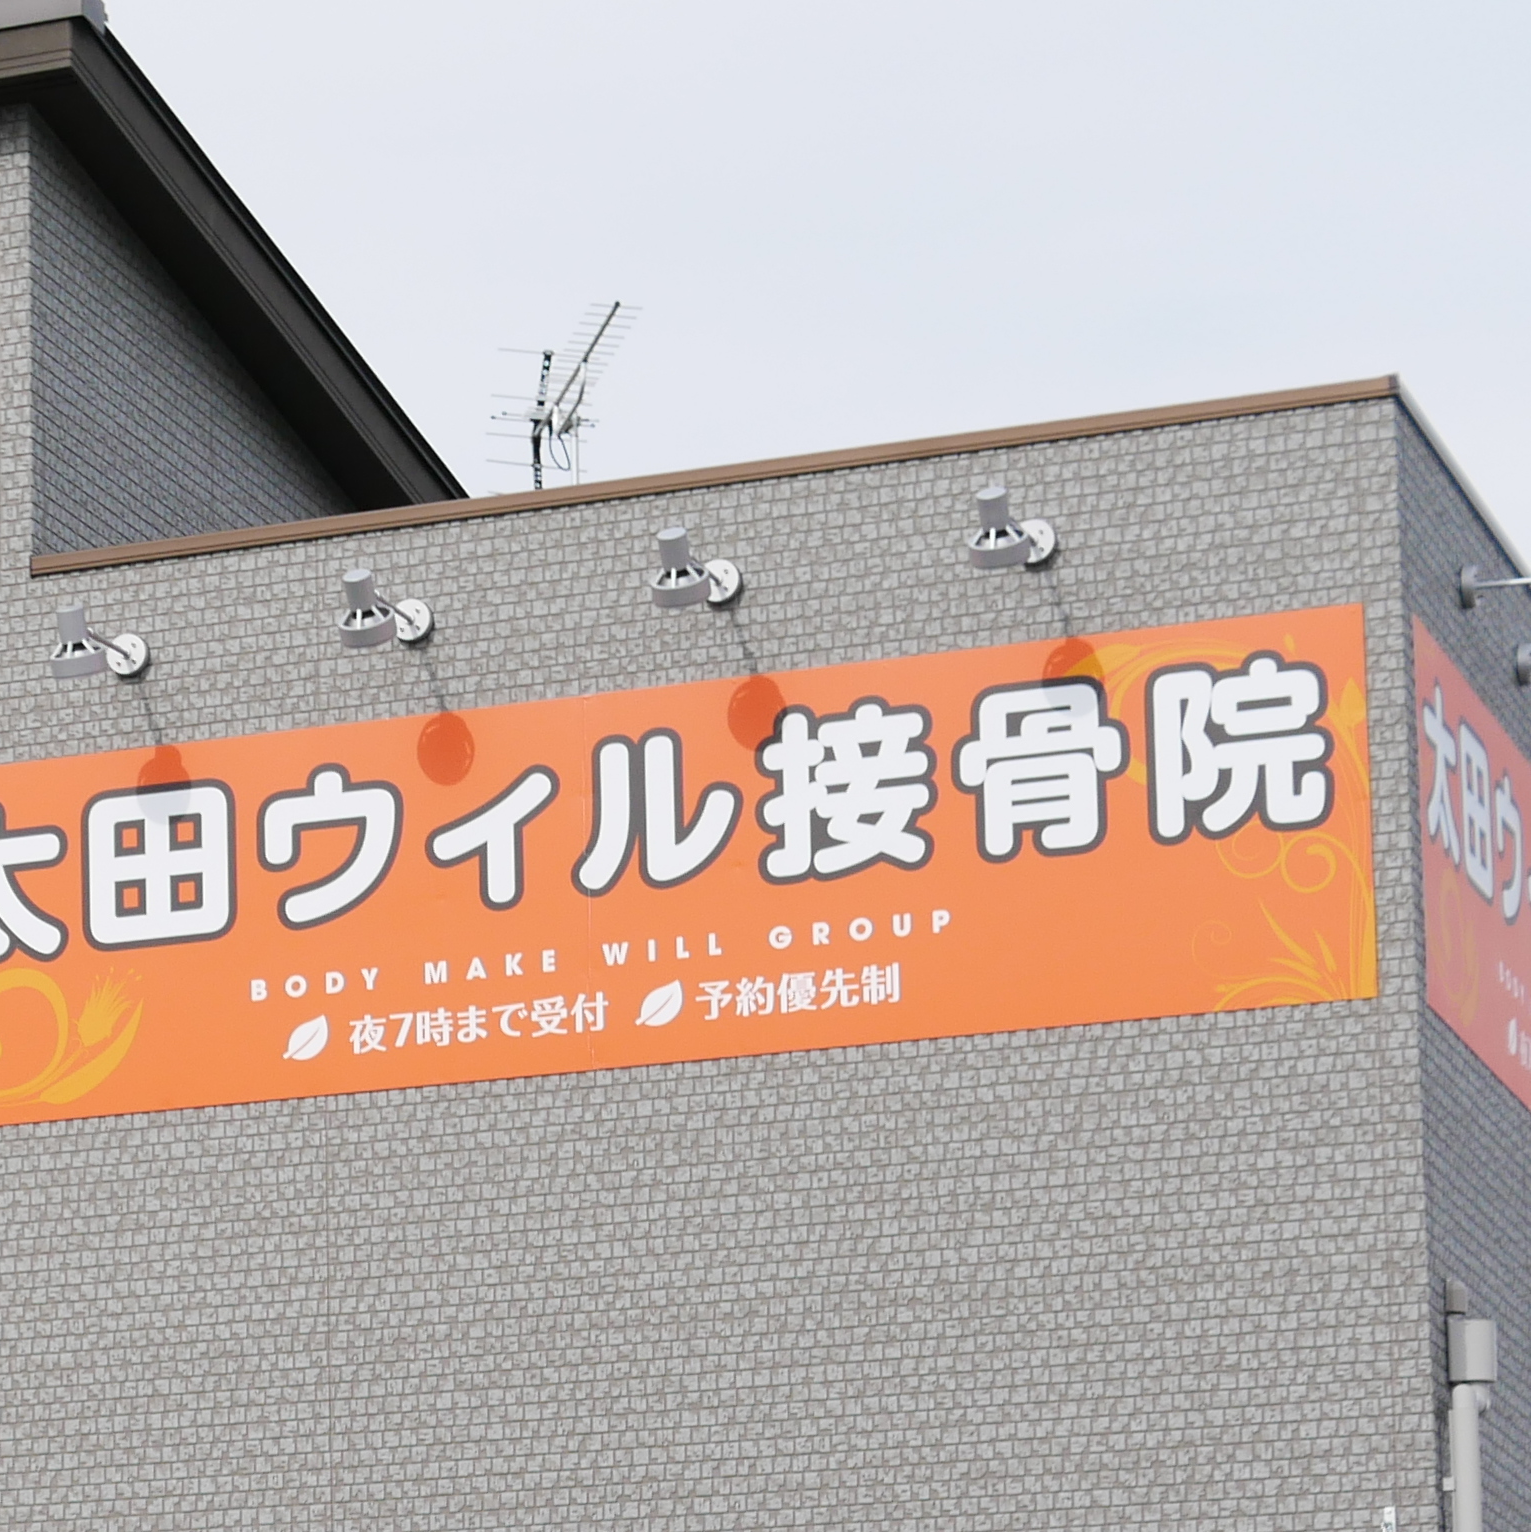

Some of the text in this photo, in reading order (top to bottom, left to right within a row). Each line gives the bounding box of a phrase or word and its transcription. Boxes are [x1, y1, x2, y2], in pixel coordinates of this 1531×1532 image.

[1423, 684, 1531, 923] 太田ウ
[250, 909, 952, 1001] BODY MAKE WILL GROUP
[349, 963, 901, 1056] 夜7時まで受付 予約優先制
